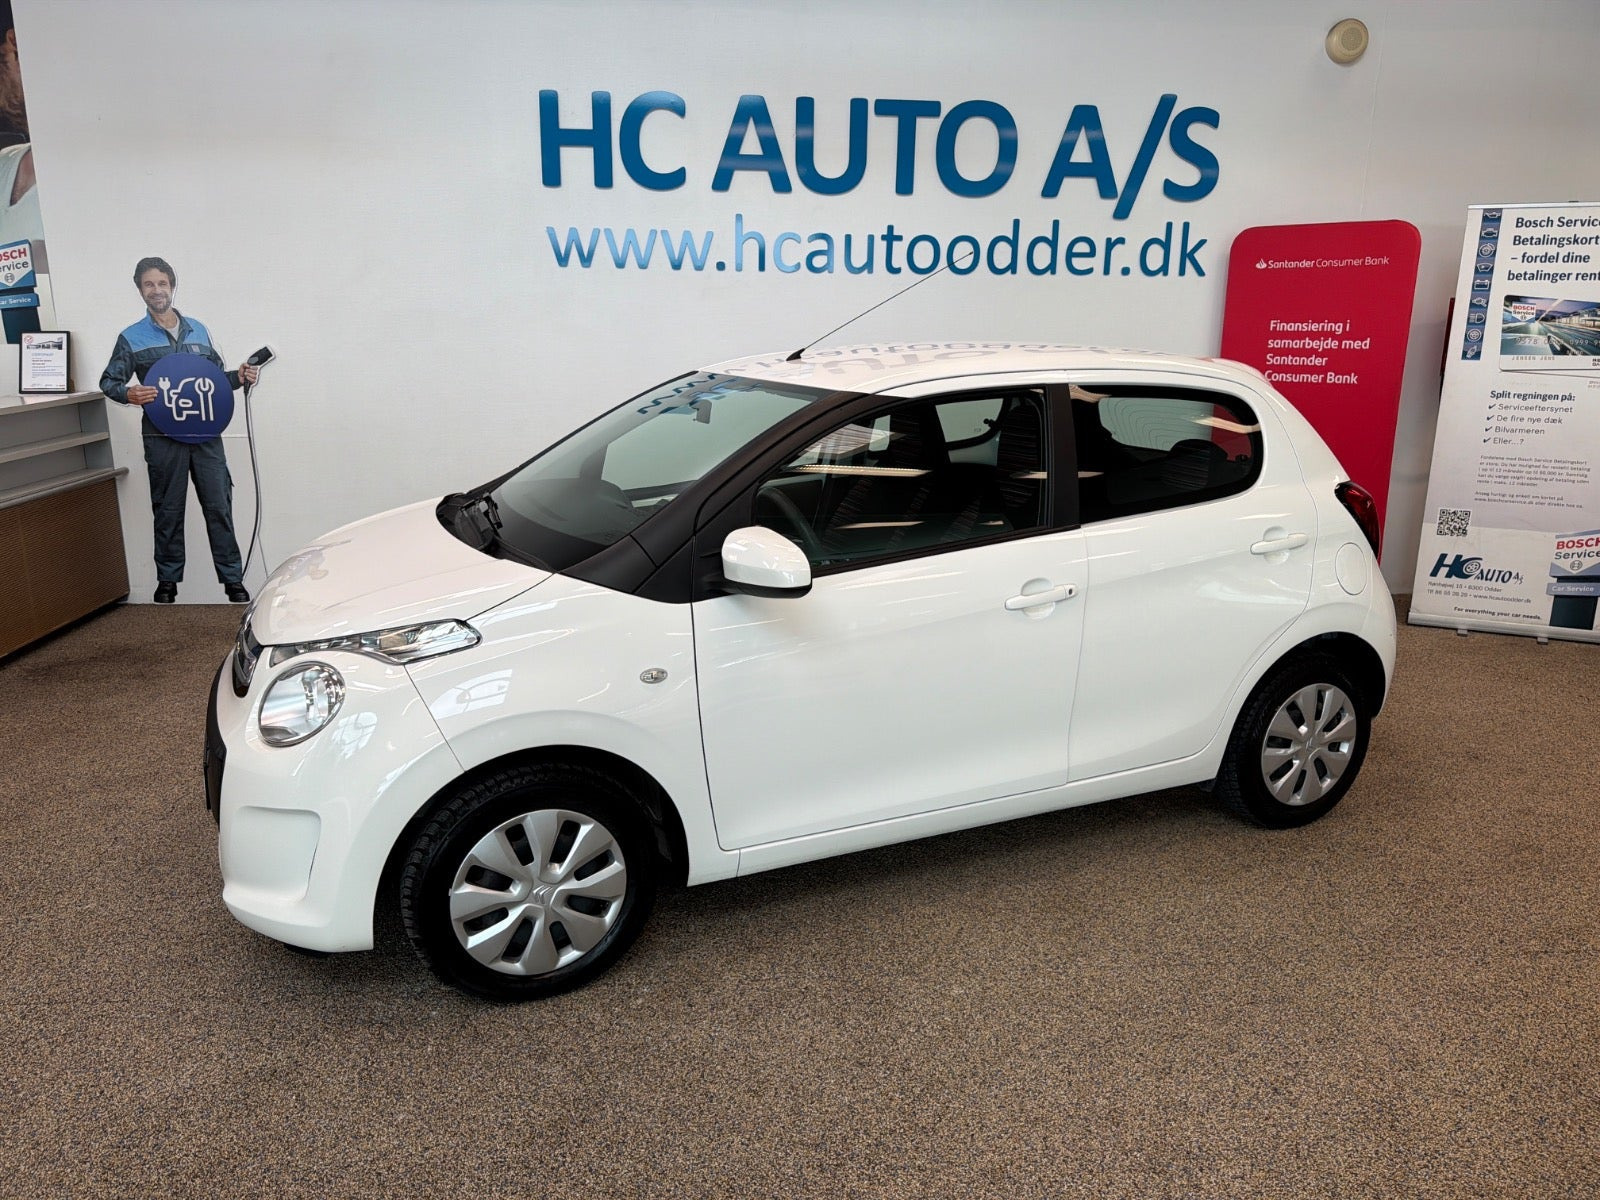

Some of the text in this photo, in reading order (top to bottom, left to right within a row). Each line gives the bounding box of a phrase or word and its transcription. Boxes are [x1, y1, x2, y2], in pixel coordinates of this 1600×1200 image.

[538, 89, 1221, 220] HC AUTO A/S
[1516, 216, 1600, 228] Bosch Servic
[546, 213, 1208, 278] www.hcautoodder.dk
[1512, 234, 1600, 248] Betalingskort
[1268, 256, 1389, 269] Santander Consumer Bank
[1521, 252, 1560, 263] fordel
[1562, 252, 1590, 263] dine
[1507, 270, 1572, 283] betalinger
[1270, 320, 1350, 334] Finansiering i
[1268, 337, 1370, 352] samarbejde med
[1266, 354, 1328, 366] Santander
[1264, 370, 1359, 384] Consumer Bank
[1490, 390, 1576, 402] Split regningen på:
[1498, 404, 1573, 413] Serviceeftersynet
[1495, 426, 1545, 434] Bilvarmeren
[1474, 569, 1513, 583] AUTO
